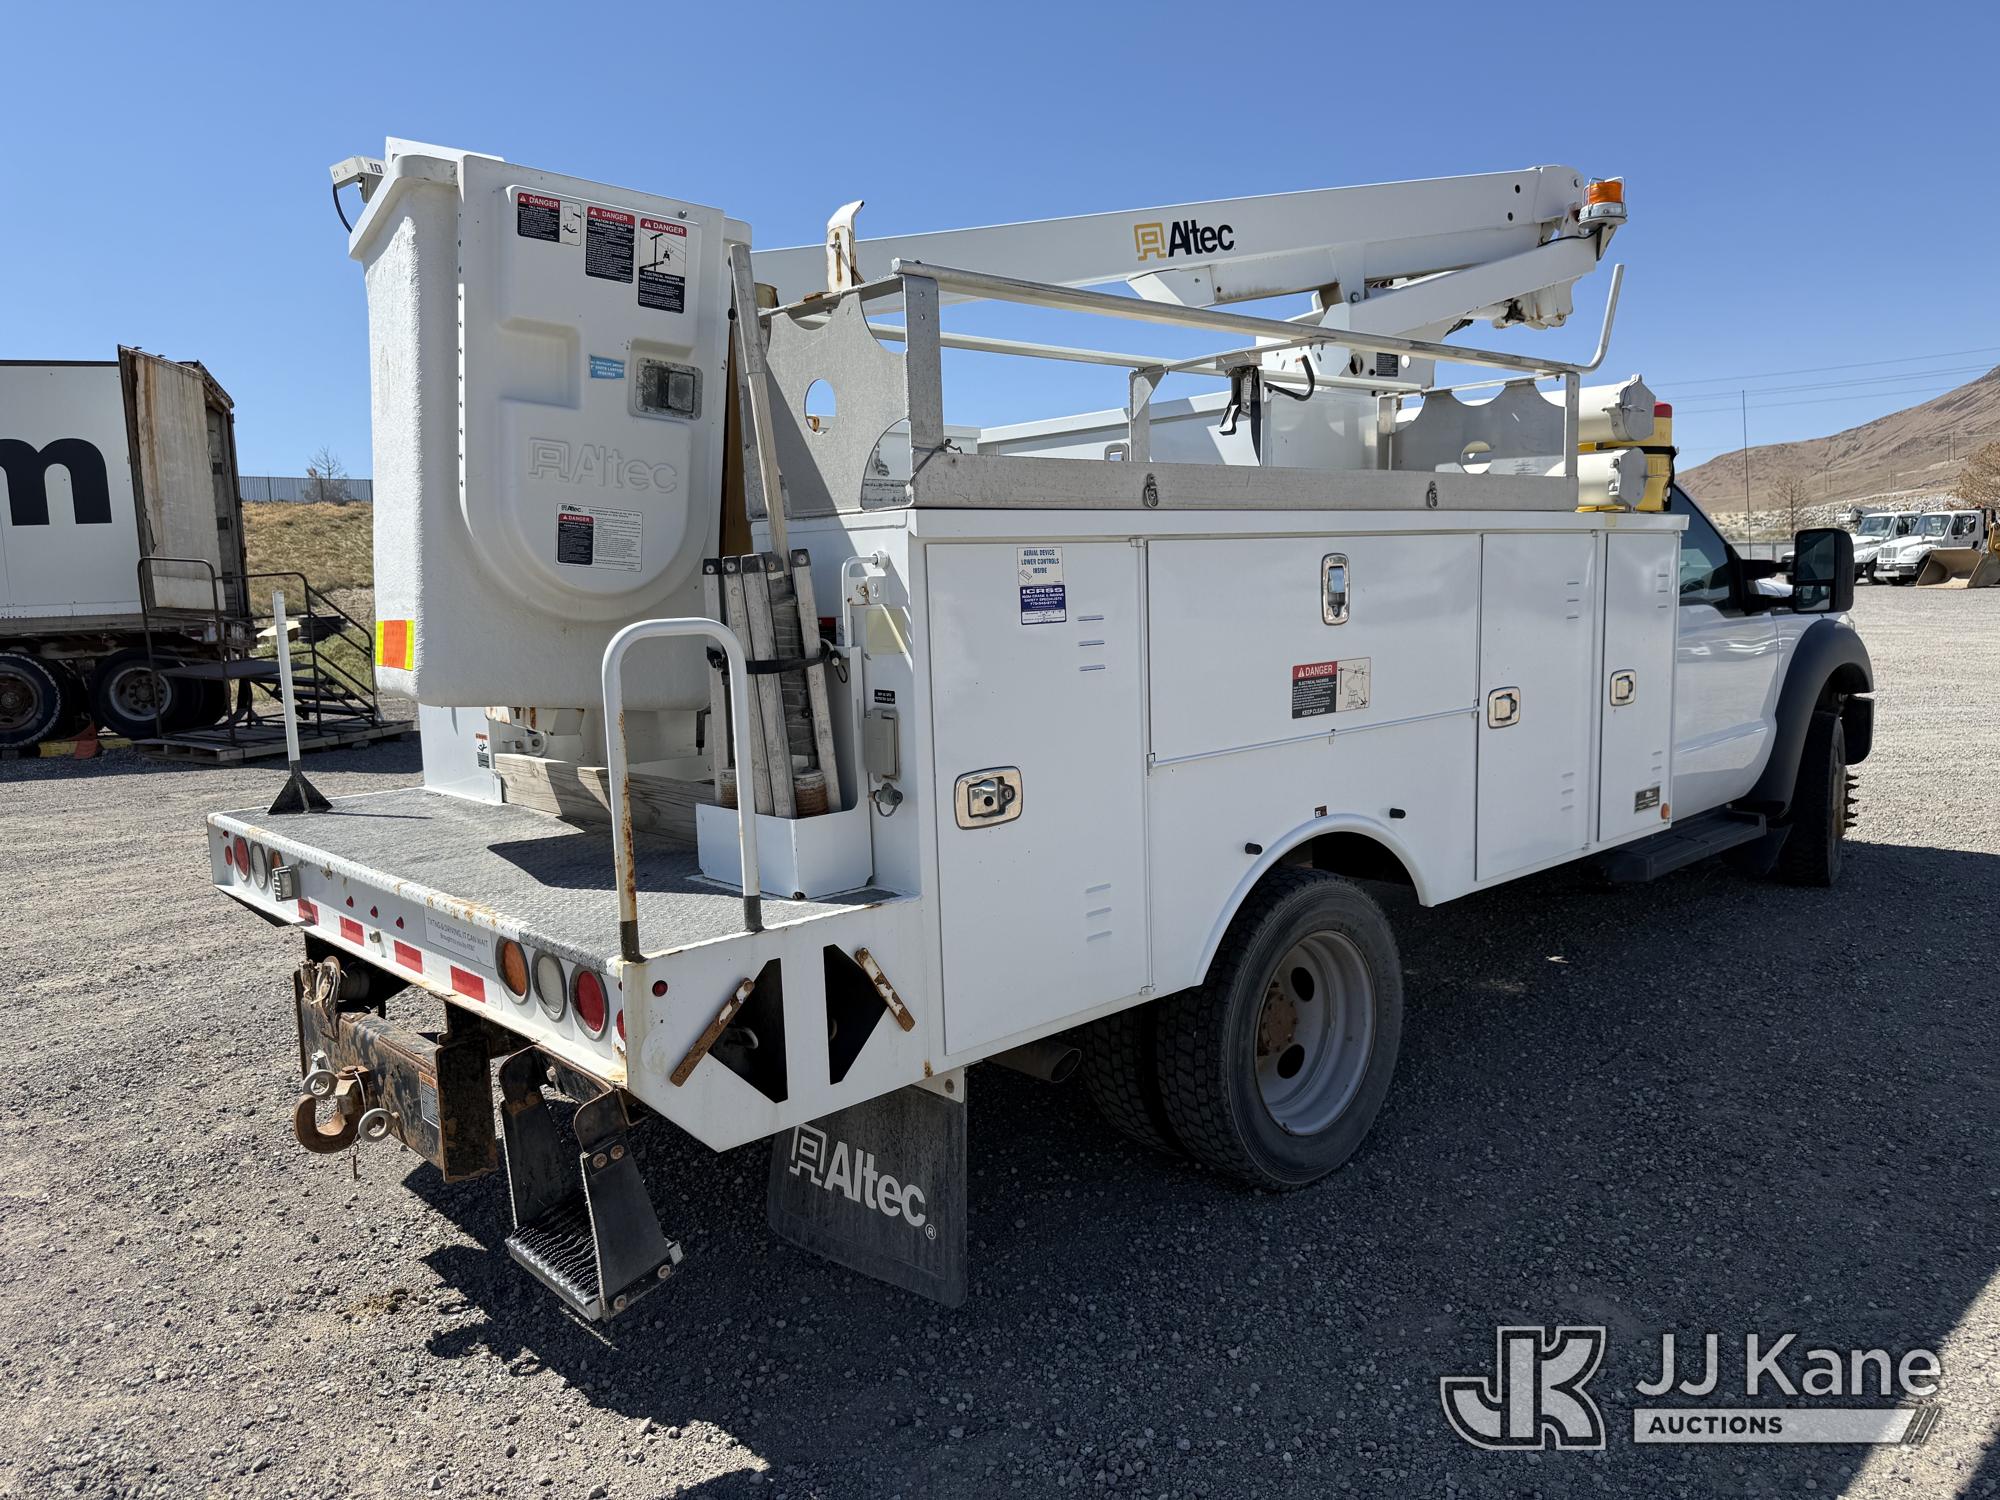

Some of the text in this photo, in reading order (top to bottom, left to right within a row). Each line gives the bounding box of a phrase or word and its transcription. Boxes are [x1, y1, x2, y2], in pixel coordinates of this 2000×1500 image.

[529, 197, 559, 208] DANGER
[602, 211, 628, 222] DANGER
[653, 222, 684, 235] DANGER
[1168, 219, 1235, 258] Altec
[571, 443, 678, 494] Altec
[567, 505, 582, 513] Altec
[1021, 558, 1037, 566] LOWER
[1305, 665, 1332, 676] DANGER
[1312, 706, 1325, 714] CLEAR
[824, 1141, 926, 1227] Altec
